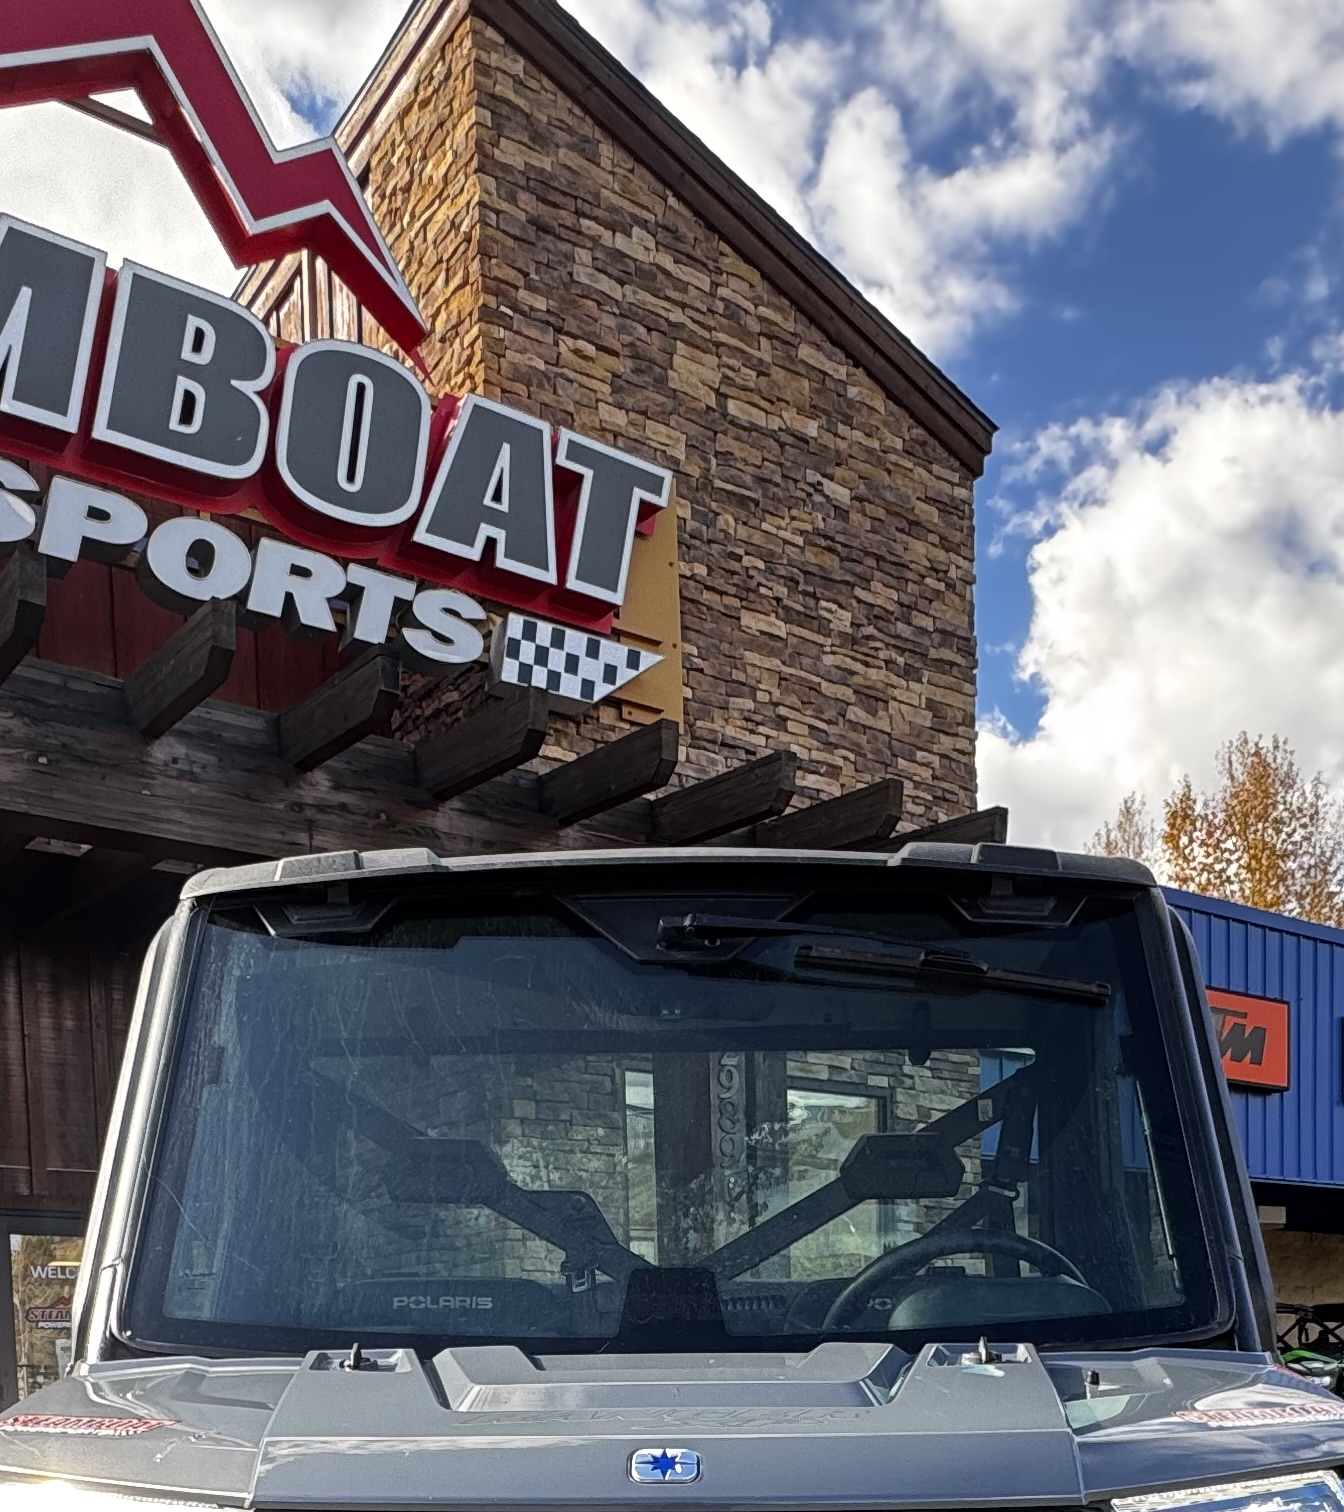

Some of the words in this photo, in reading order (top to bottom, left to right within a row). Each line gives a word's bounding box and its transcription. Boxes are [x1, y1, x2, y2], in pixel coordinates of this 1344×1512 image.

[1209, 1006, 1267, 1067] TM
[30, 1265, 79, 1280] WELC
[392, 1296, 494, 1310] POLARIS
